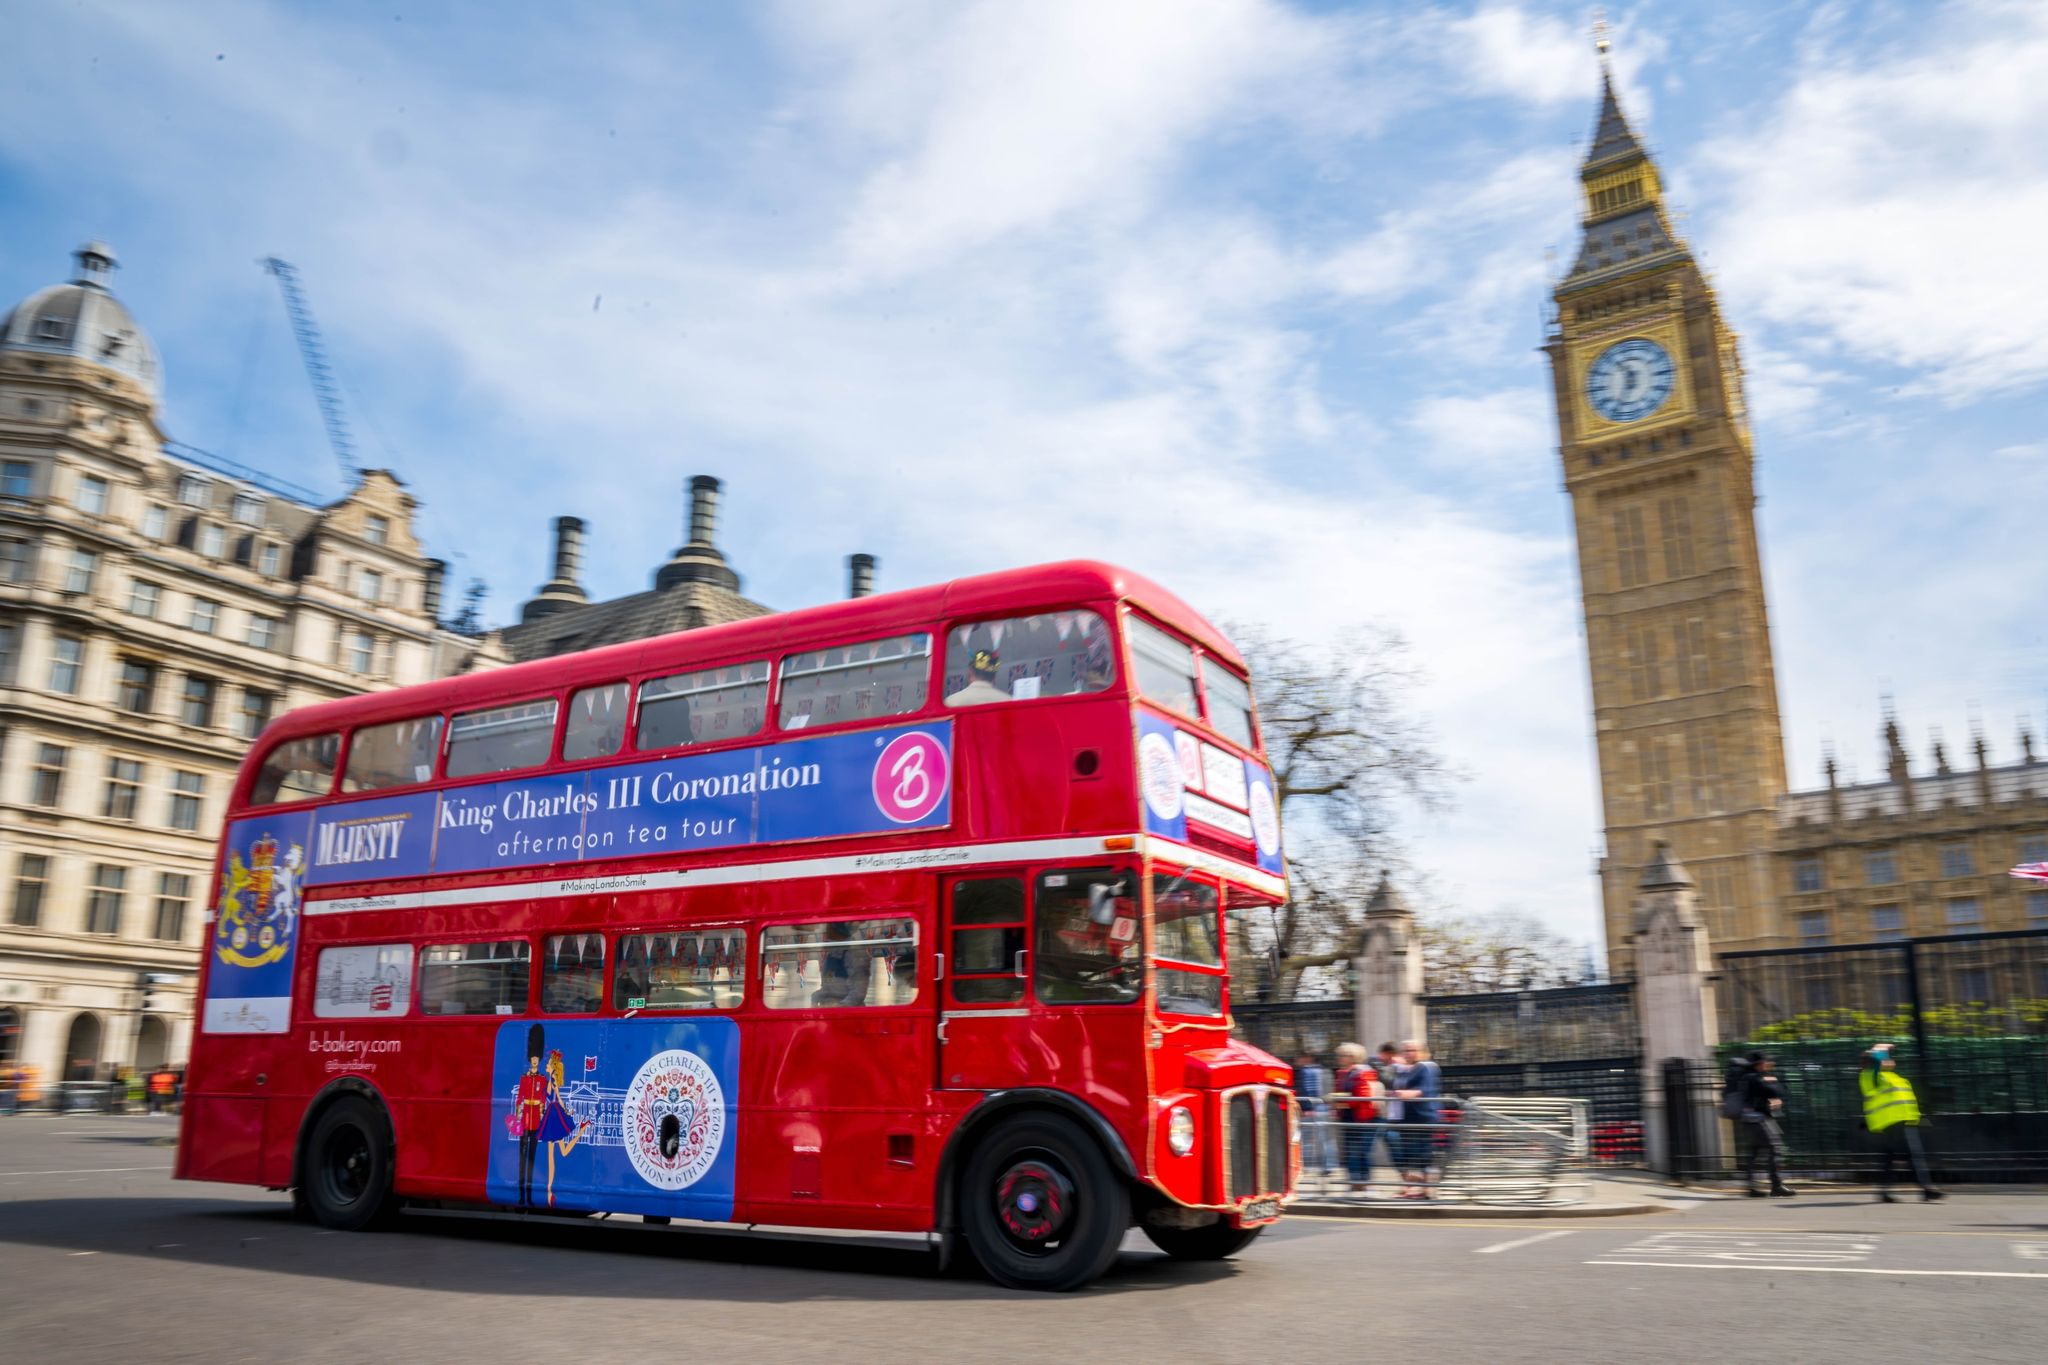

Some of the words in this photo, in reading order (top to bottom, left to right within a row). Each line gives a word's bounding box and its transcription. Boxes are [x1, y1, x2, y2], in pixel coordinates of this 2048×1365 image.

[440, 800, 497, 834] King
[502, 785, 598, 822] Charles
[606, 776, 641, 810] III
[651, 757, 822, 804] Coronation
[497, 830, 614, 857] afternoon
[627, 824, 667, 844] tea
[682, 816, 737, 839] tour
[560, 874, 647, 893] #MakingLondonSmile
[309, 1031, 401, 1059] b-bakery.com
[635, 1065, 657, 1093] KING
[658, 1056, 706, 1079] CHARLES
[703, 1078, 716, 1094] III
[626, 1105, 664, 1183] CORONATION
[675, 1168, 697, 1184] 6TH
[697, 1142, 716, 1170] MAY
[711, 1107, 721, 1141] 2023
